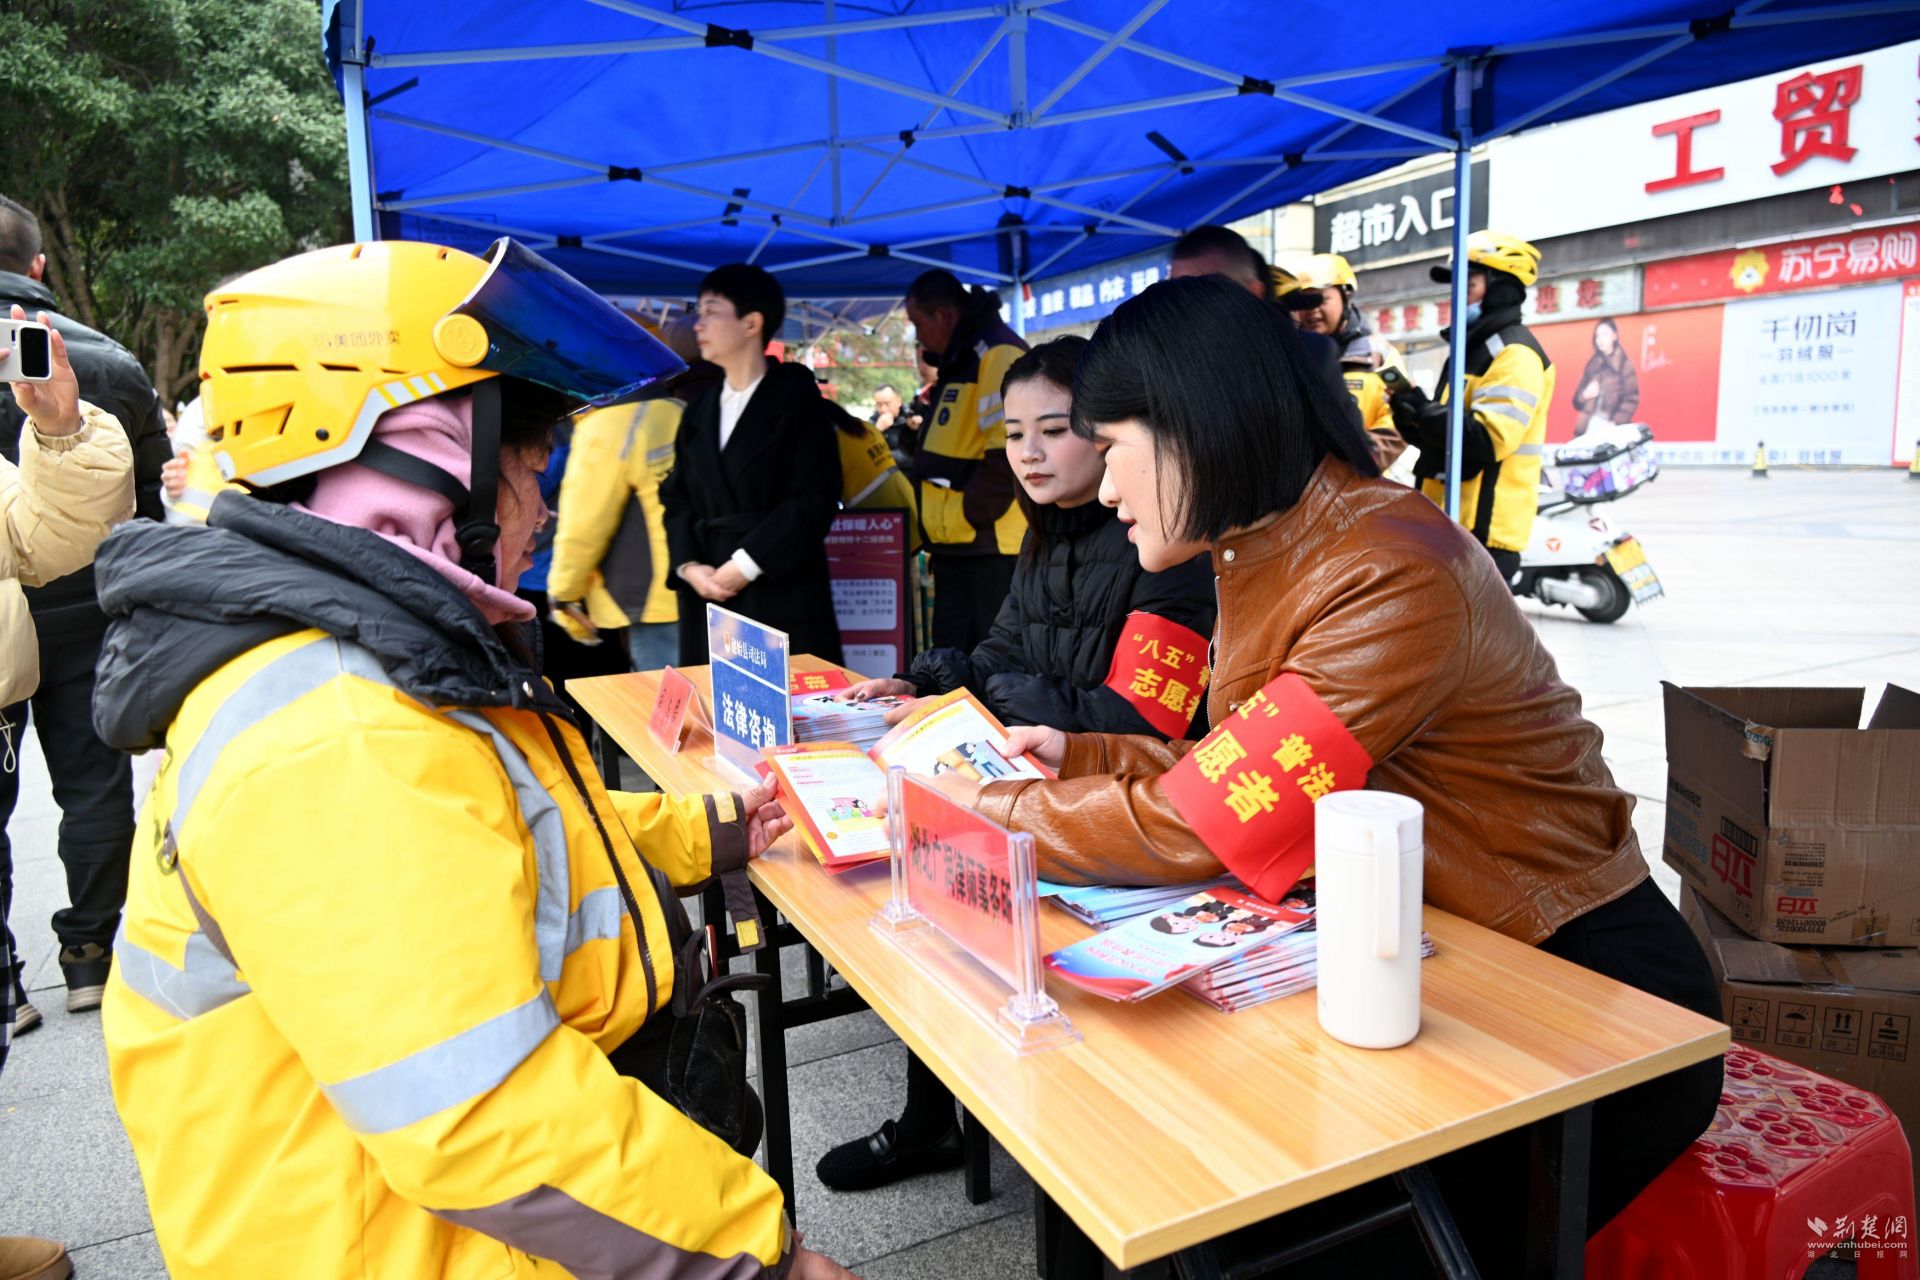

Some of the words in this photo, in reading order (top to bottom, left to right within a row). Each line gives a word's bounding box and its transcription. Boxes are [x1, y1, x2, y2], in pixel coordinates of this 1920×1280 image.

[1645, 64, 1919, 194] 工贸
[1331, 186, 1456, 251] 超市入口
[1778, 231, 1917, 283] 苏宁易购
[1132, 633, 1196, 670] “八五”
[721, 692, 776, 748] 法律咨询
[1192, 725, 1280, 824] 愿者
[1271, 732, 1336, 804] 普法
